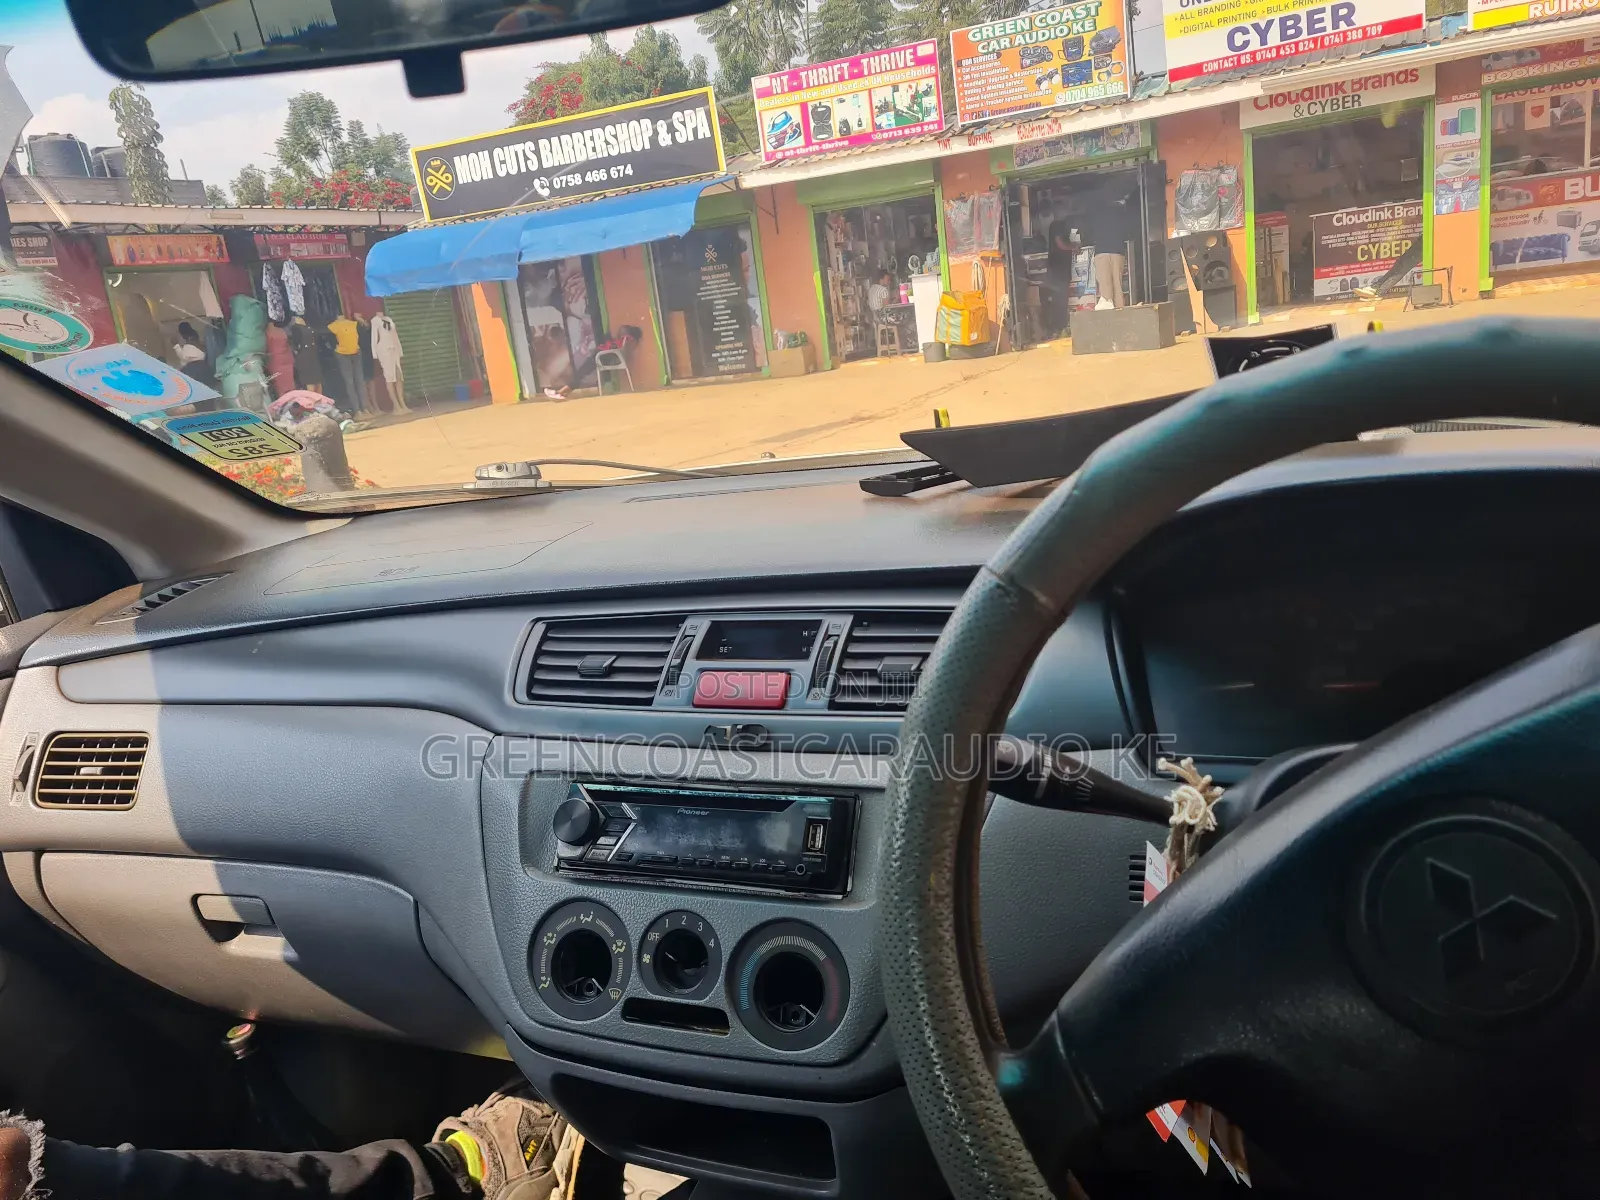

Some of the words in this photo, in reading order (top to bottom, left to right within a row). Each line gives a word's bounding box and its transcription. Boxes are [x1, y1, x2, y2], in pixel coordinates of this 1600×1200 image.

[967, 17, 1033, 43] GREEN
[1034, 1, 1102, 28] COAST
[1183, 21, 1214, 34] DIGITAL
[1217, 10, 1257, 26] PRINTING
[1197, 0, 1241, 17] BRANDING
[1266, 2, 1290, 15] BULK
[977, 36, 1014, 54] CAR
[1014, 23, 1071, 47] AUDIO
[1071, 18, 1097, 34] KE
[1226, 2, 1357, 52] CYBER
[1202, 58, 1238, 73] CONTACT
[1240, 55, 1254, 64] US:
[1279, 44, 1296, 56] 453
[1324, 34, 1344, 46] 0741
[1346, 30, 1363, 41] 380
[1366, 25, 1383, 36] 709
[771, 74, 790, 95] NT
[799, 62, 850, 89] THRIFT
[860, 48, 916, 76] THRIVE
[1483, 58, 1580, 84] BOOKING
[1585, 55, 1599, 65] &
[758, 95, 792, 109] Dealers
[883, 65, 937, 84] Households
[1293, 104, 1304, 118] &
[1307, 93, 1362, 116] CYBER
[453, 150, 494, 185] MOH
[493, 141, 539, 177] CUTS
[539, 118, 653, 166] BARBERSHOP
[657, 120, 672, 147] &
[672, 107, 711, 143] SPA
[552, 172, 582, 190] 0758
[584, 168, 608, 187] 466
[608, 163, 634, 183] 674
[1332, 208, 1394, 227] CloudInk
[27, 236, 48, 248] SHOP
[676, 808, 710, 816] Pioneer
[647, 931, 660, 943] OFF
[665, 918, 669, 929] 1
[681, 915, 687, 925] 2
[697, 921, 703, 932] 3
[708, 938, 715, 949] 4
